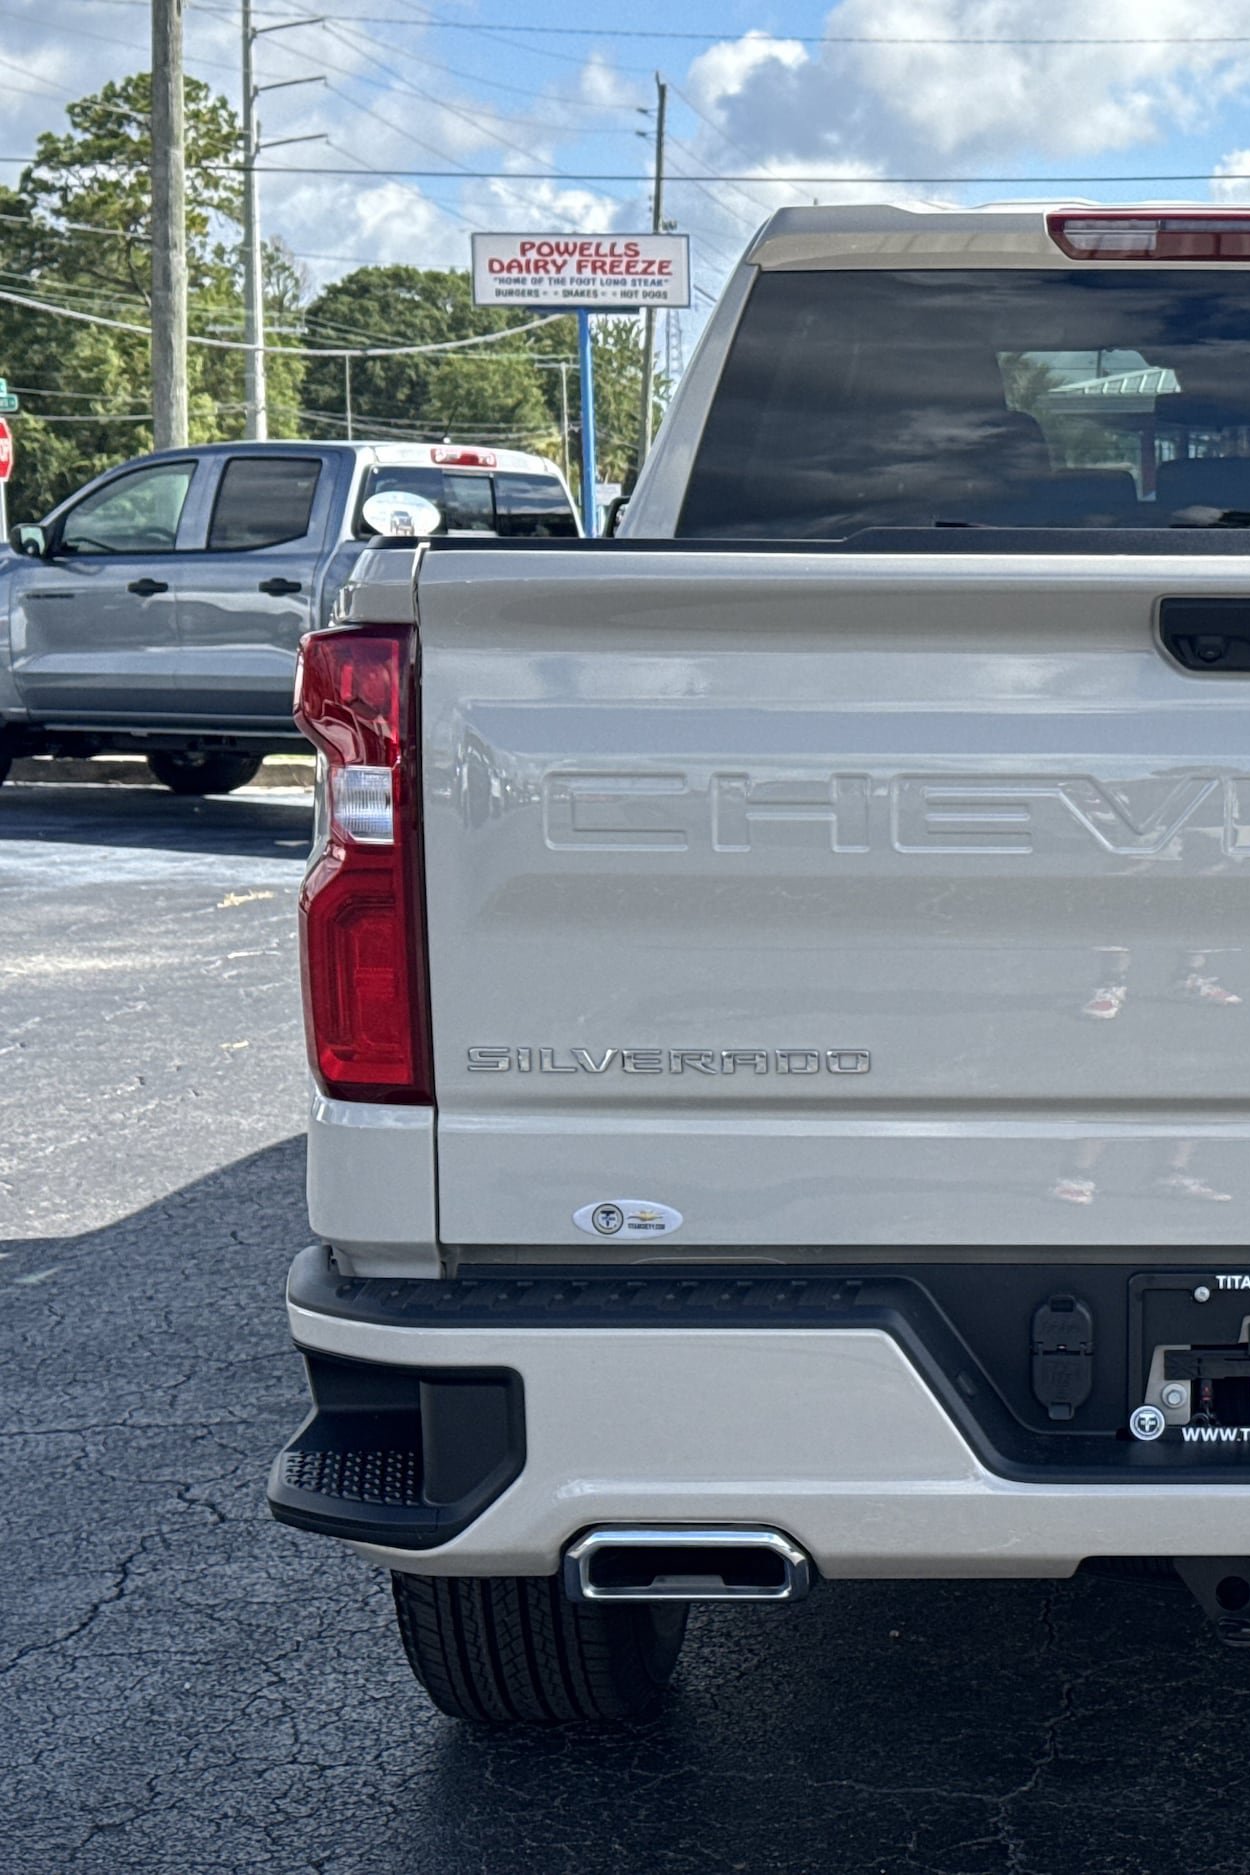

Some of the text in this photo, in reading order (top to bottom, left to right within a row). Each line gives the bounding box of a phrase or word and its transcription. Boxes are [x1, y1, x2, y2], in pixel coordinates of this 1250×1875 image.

[519, 241, 641, 259] POWELLS
[487, 258, 673, 276] DAIRY FREEZE
[530, 277, 544, 286] OF
[547, 277, 567, 286] THE
[569, 277, 597, 286] FOOT
[599, 278, 627, 287] LONG
[494, 288, 669, 300] BURGERS SHAKES HOT DOGS
[467, 1046, 872, 1075] SILVERADO
